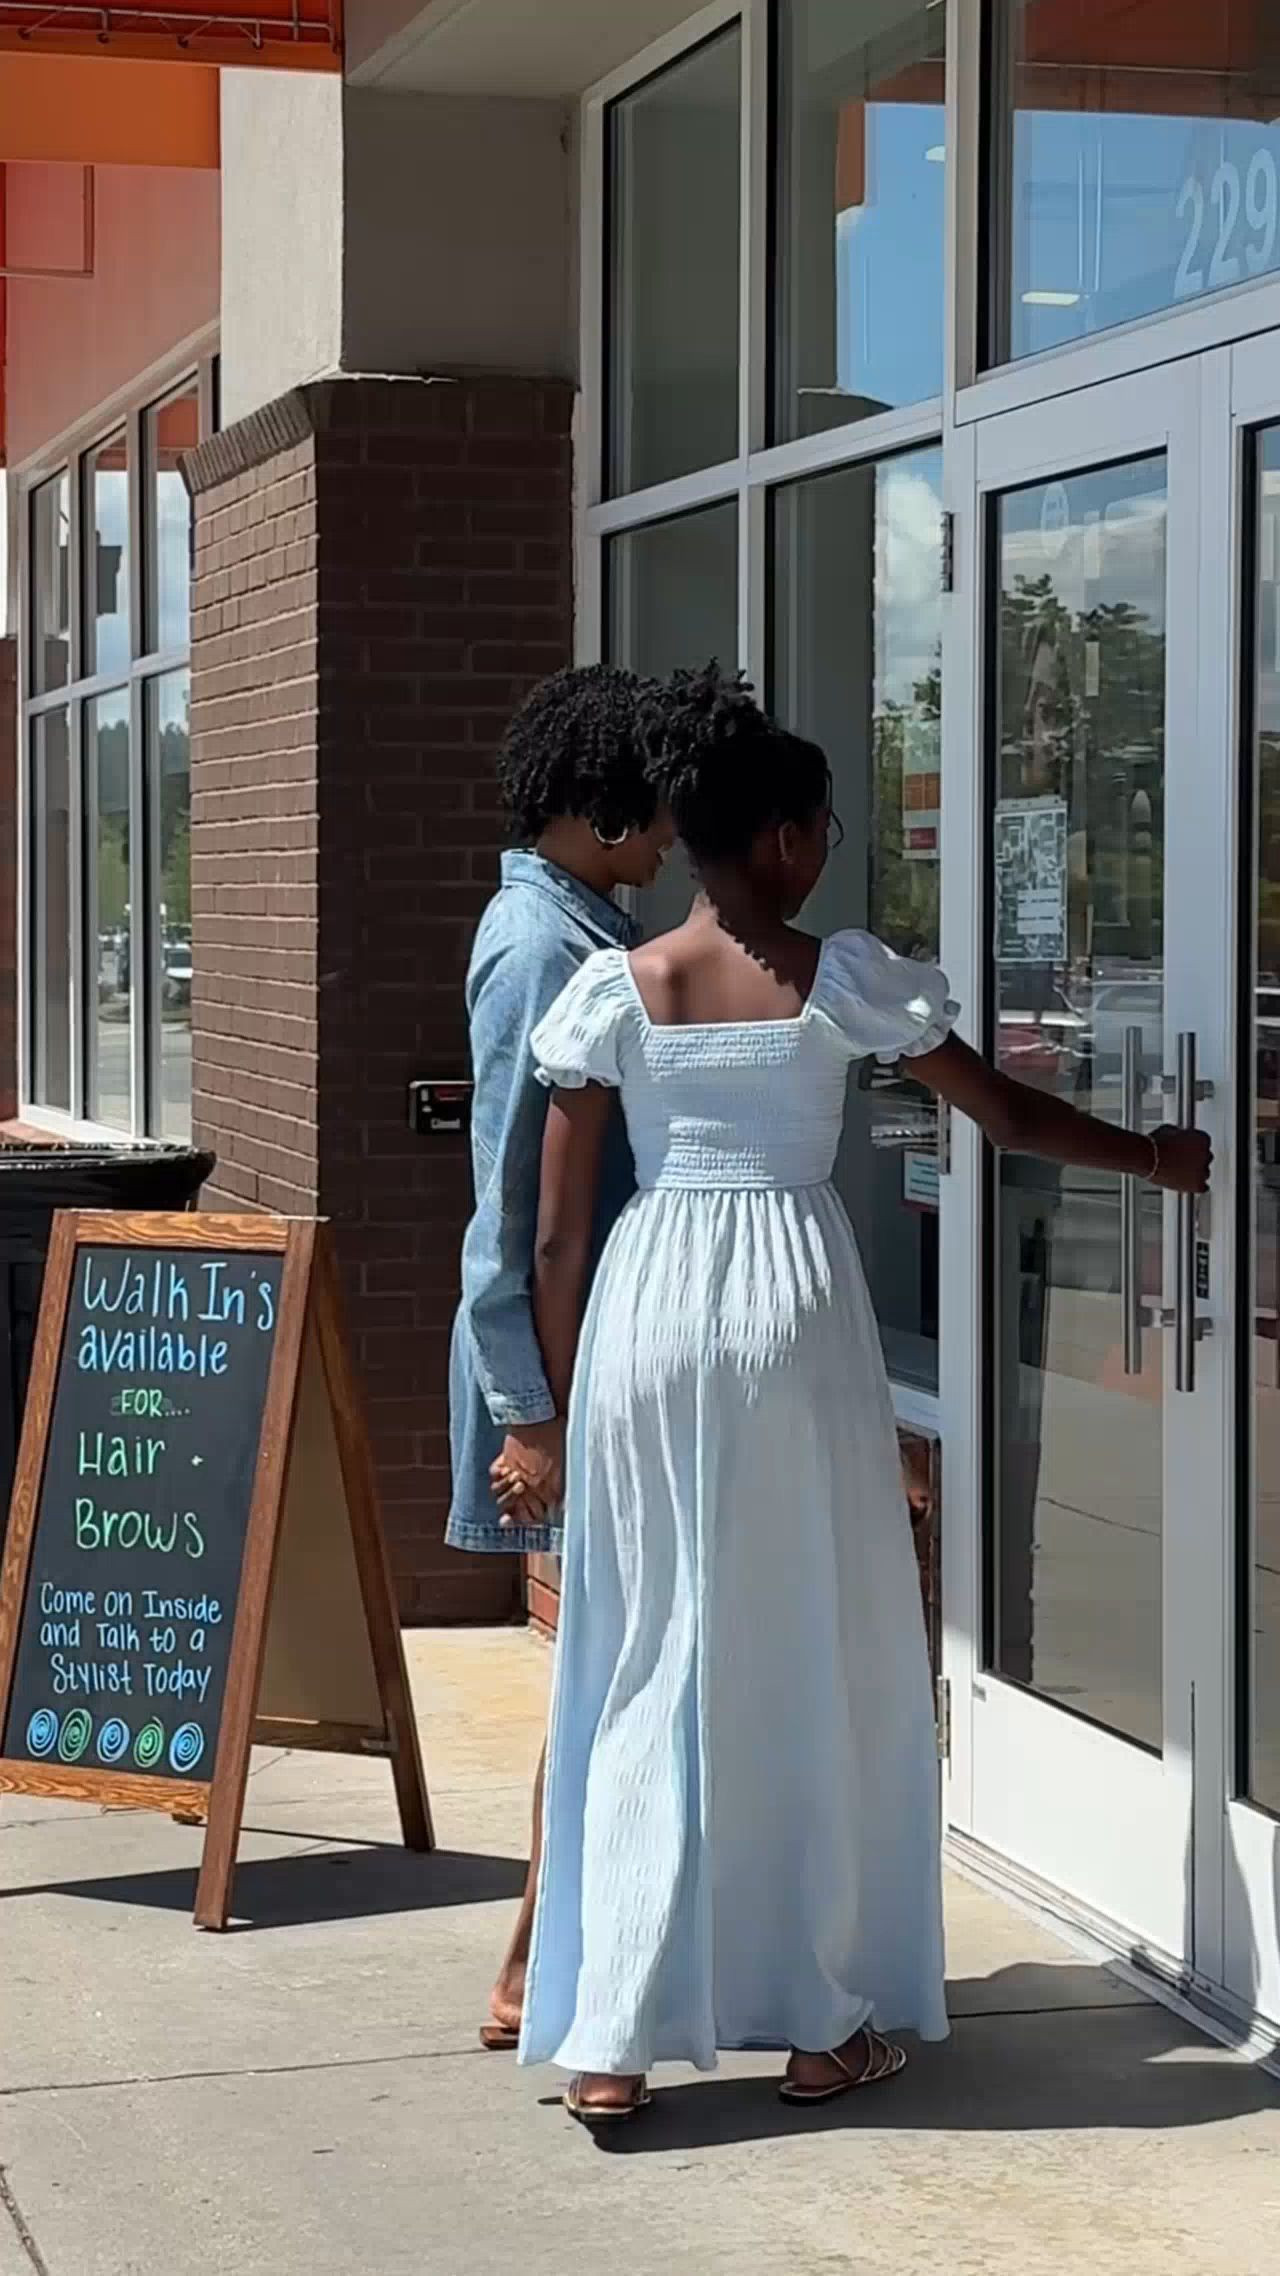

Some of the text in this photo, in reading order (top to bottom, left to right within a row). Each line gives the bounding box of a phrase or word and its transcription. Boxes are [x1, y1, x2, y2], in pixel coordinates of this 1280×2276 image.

[1174, 148, 1278, 299] 229
[84, 1256, 275, 1330] Walk In's
[78, 1325, 228, 1377] available
[79, 1432, 165, 1477] Hair
[75, 1498, 204, 1558] Brows
[41, 1582, 222, 1624] Come on Inside
[40, 1619, 204, 1653] and Talk to a
[50, 1653, 212, 1703] Stylist Today
